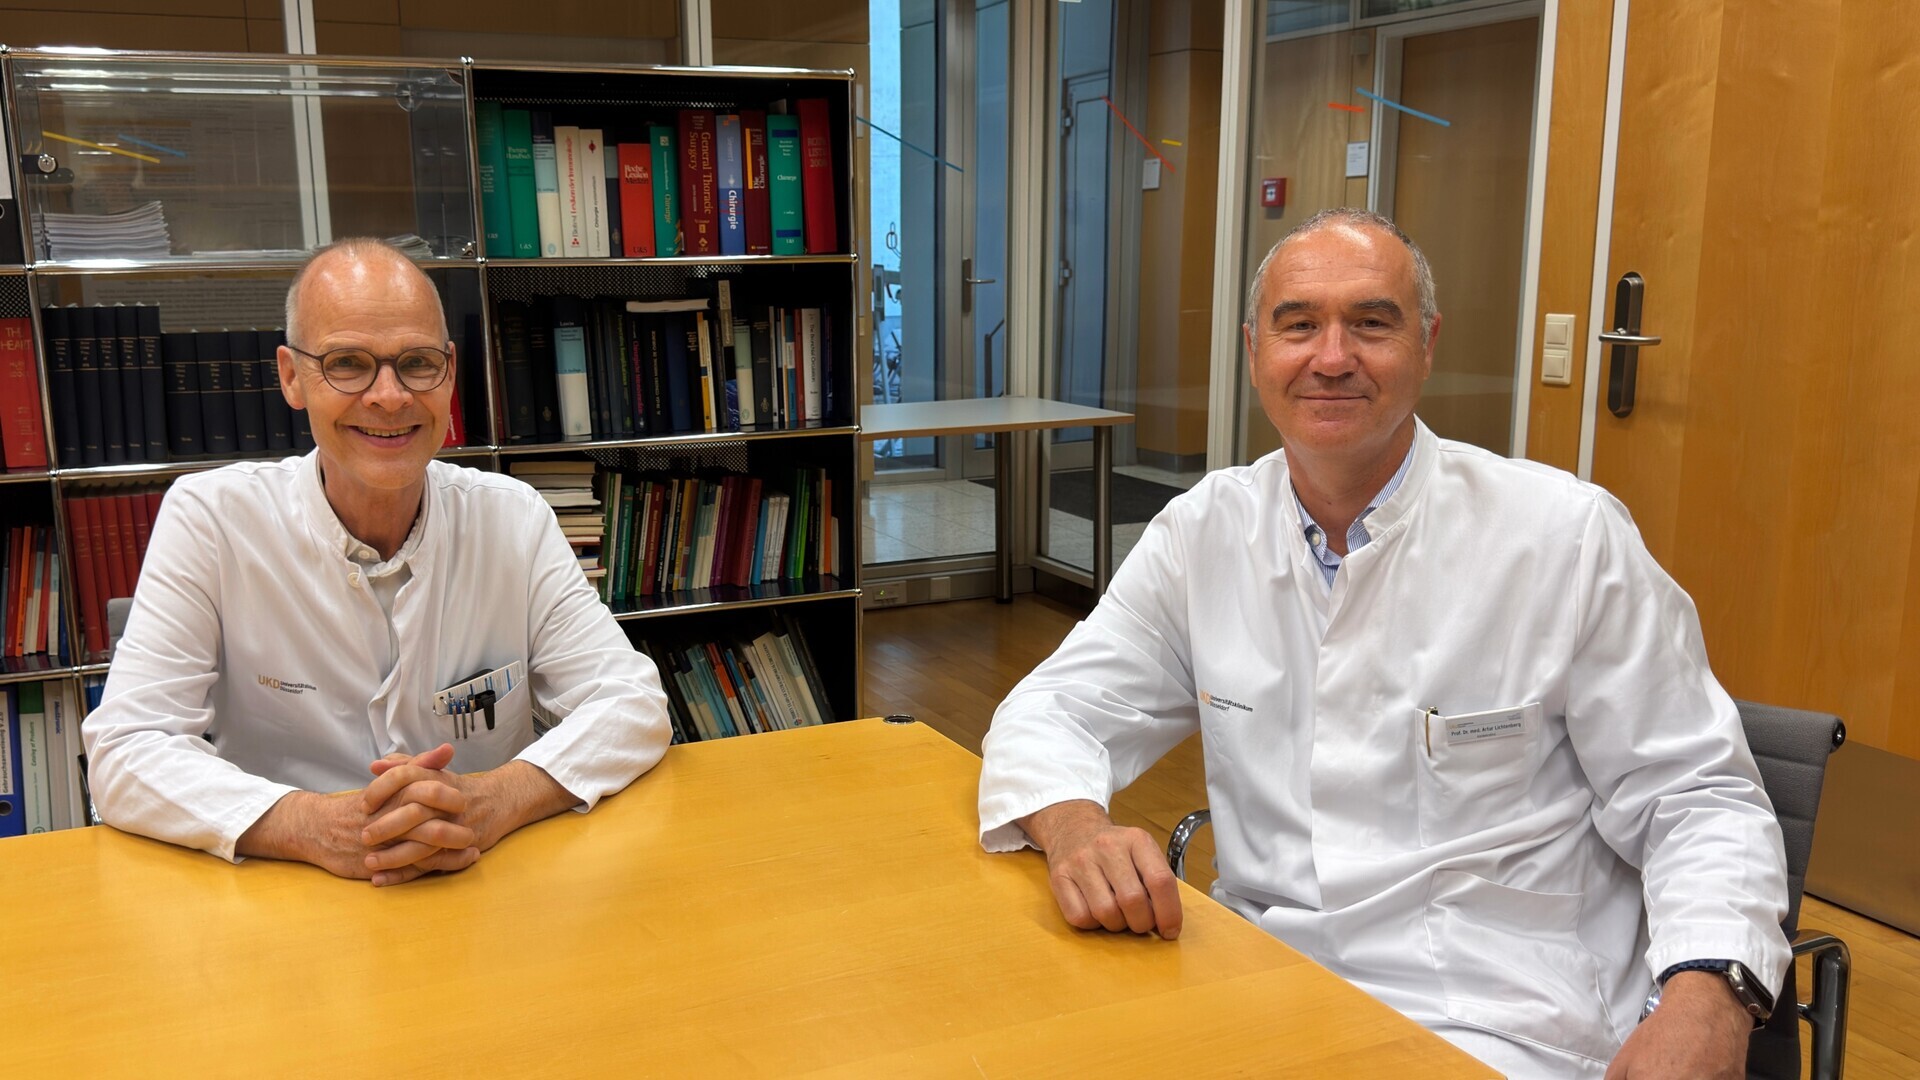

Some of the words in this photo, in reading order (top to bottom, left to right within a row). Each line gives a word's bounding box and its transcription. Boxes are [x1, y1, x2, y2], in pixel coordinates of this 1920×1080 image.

[688, 131, 699, 171] Surgery
[701, 131, 712, 170] General
[624, 164, 643, 172] Roche
[624, 171, 649, 179] Lexikon
[757, 154, 766, 189] Chirurgie
[703, 173, 714, 215] Thoracic
[728, 189, 738, 230] Chirurgie
[633, 246, 648, 254] U&S
[5, 327, 22, 339] THE
[0, 339, 31, 351] HEART
[258, 675, 280, 689] UKD
[280, 686, 304, 695] Düsseldorf
[1210, 695, 1253, 712] Universitätsklinikum
[54, 700, 62, 735] Medtronic
[1495, 722, 1521, 731] Lichtenberg
